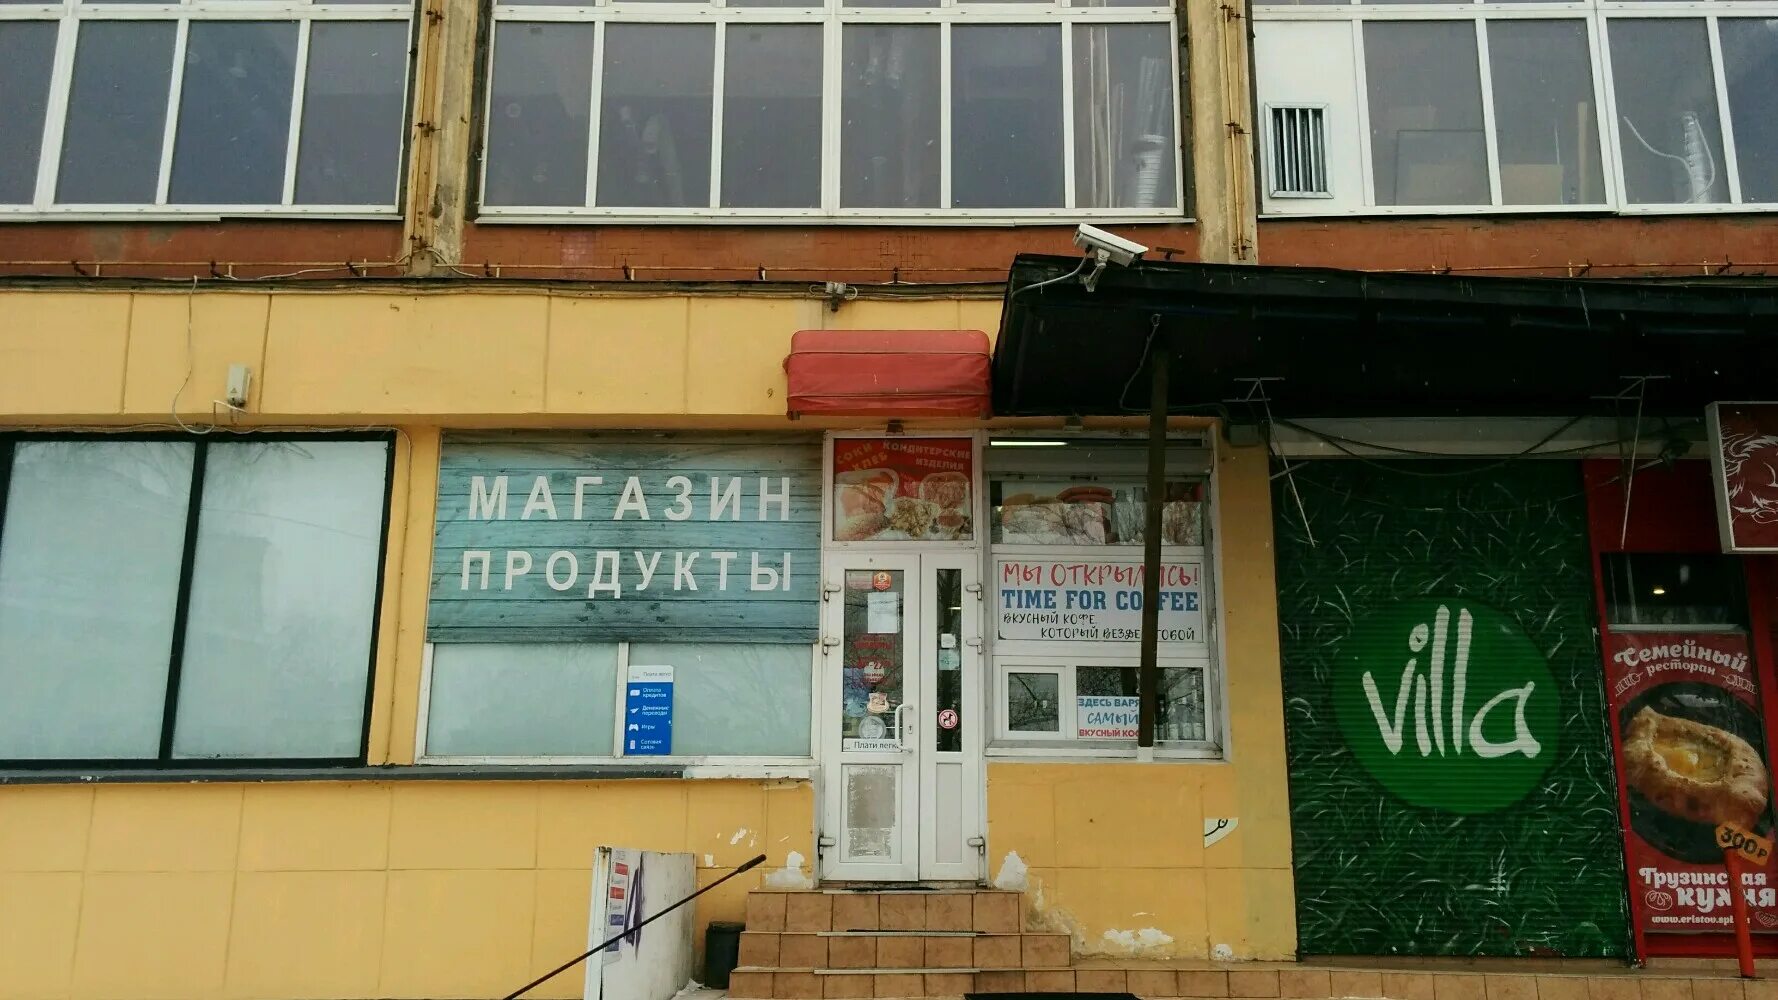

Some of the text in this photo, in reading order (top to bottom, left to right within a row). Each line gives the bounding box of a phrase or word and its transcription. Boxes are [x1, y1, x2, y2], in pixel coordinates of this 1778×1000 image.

[916, 458, 964, 470] ИЗДЕЛИЯ
[468, 475, 790, 520] МАГАЗИН
[460, 550, 791, 599] ПРОДУКТЫ
[1001, 589, 1199, 612] TIME FOR COFEE
[1003, 611, 1058, 625] ВКУСНЫЙ
[1041, 626, 1098, 639] КОТОРЫЙ
[1613, 639, 1748, 673] Семейный
[1645, 658, 1716, 677] ресторан
[1362, 604, 1541, 759] villa
[1078, 698, 1112, 708] ЗДЕСЬ
[1079, 728, 1121, 738] ВКУСНЫЙ
[854, 741, 878, 750] Плати
[1639, 867, 1767, 889] Грузинсая
